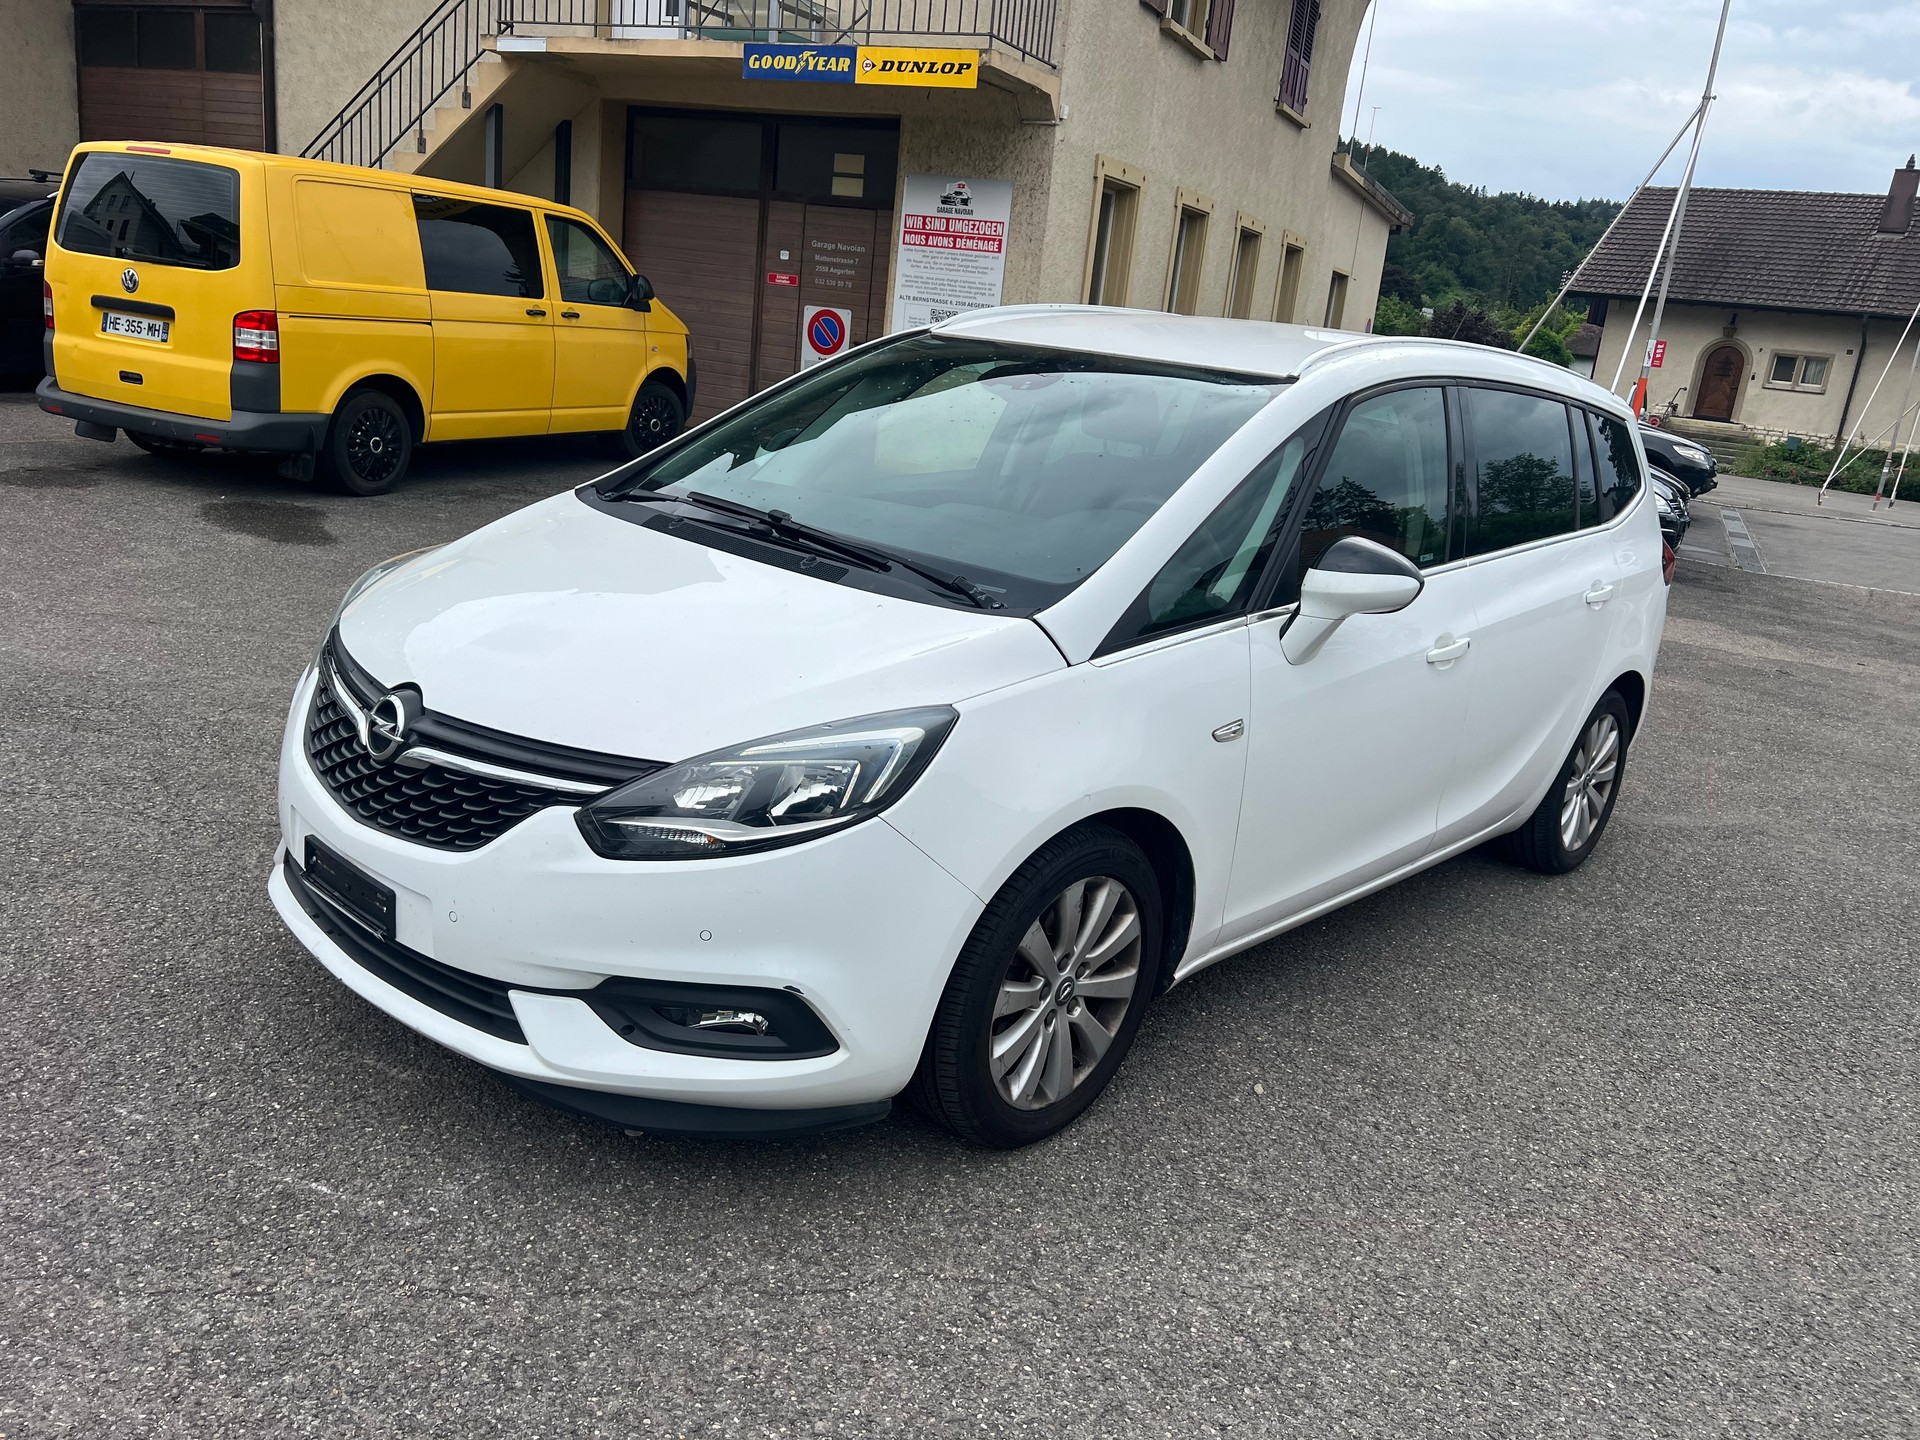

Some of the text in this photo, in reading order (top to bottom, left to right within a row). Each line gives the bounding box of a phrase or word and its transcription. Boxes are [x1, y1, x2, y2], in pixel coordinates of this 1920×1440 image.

[878, 60, 972, 75] DUNLOP
[936, 206, 954, 214] GARAGE
[905, 215, 1003, 236] WIR SIND UMGEZOGEN
[811, 240, 866, 253] Garage Navoian
[904, 233, 999, 252] NOUS AVONS DÉMÉNAGÉ
[912, 296, 948, 305] BERNSTRASSE
[108, 316, 161, 338] HE-355-MH
